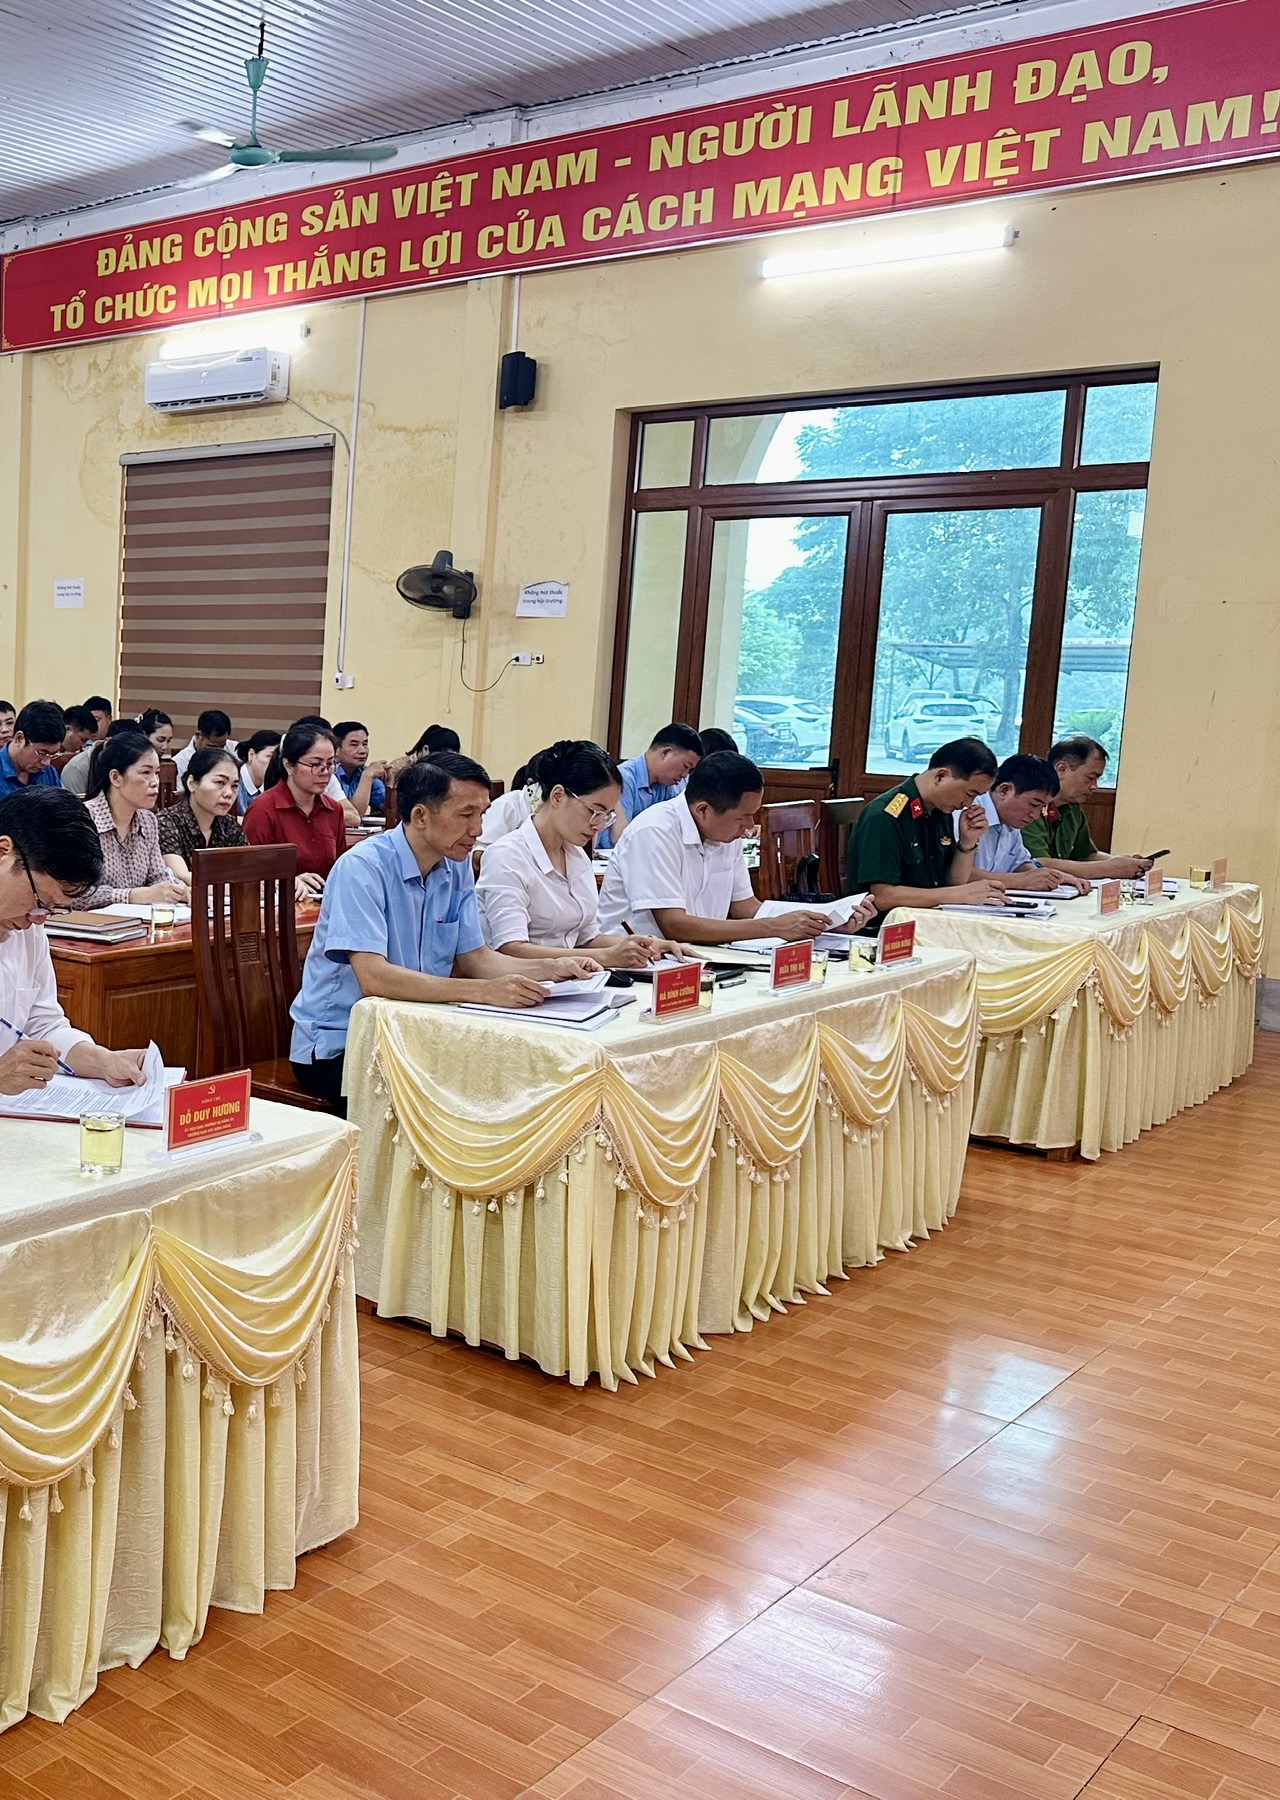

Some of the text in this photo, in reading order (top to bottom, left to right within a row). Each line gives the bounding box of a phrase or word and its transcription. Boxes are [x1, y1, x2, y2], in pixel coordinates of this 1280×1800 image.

[50, 89, 1280, 332] TỔ CHỨC MỌI THẮNG LỢI CỦA CÁCH MẠNG VIỆT NAM!
[96, 233, 183, 277] ĐẢNG
[193, 211, 288, 260] CỘNG
[300, 190, 379, 237] SẢN
[392, 171, 479, 219] VIỆT
[491, 148, 598, 200] NAM
[649, 105, 813, 172] NGƯỜI
[832, 70, 992, 138] LÃNH
[1013, 40, 1169, 104] ĐẠO,
[193, 1107, 210, 1123] DUY
